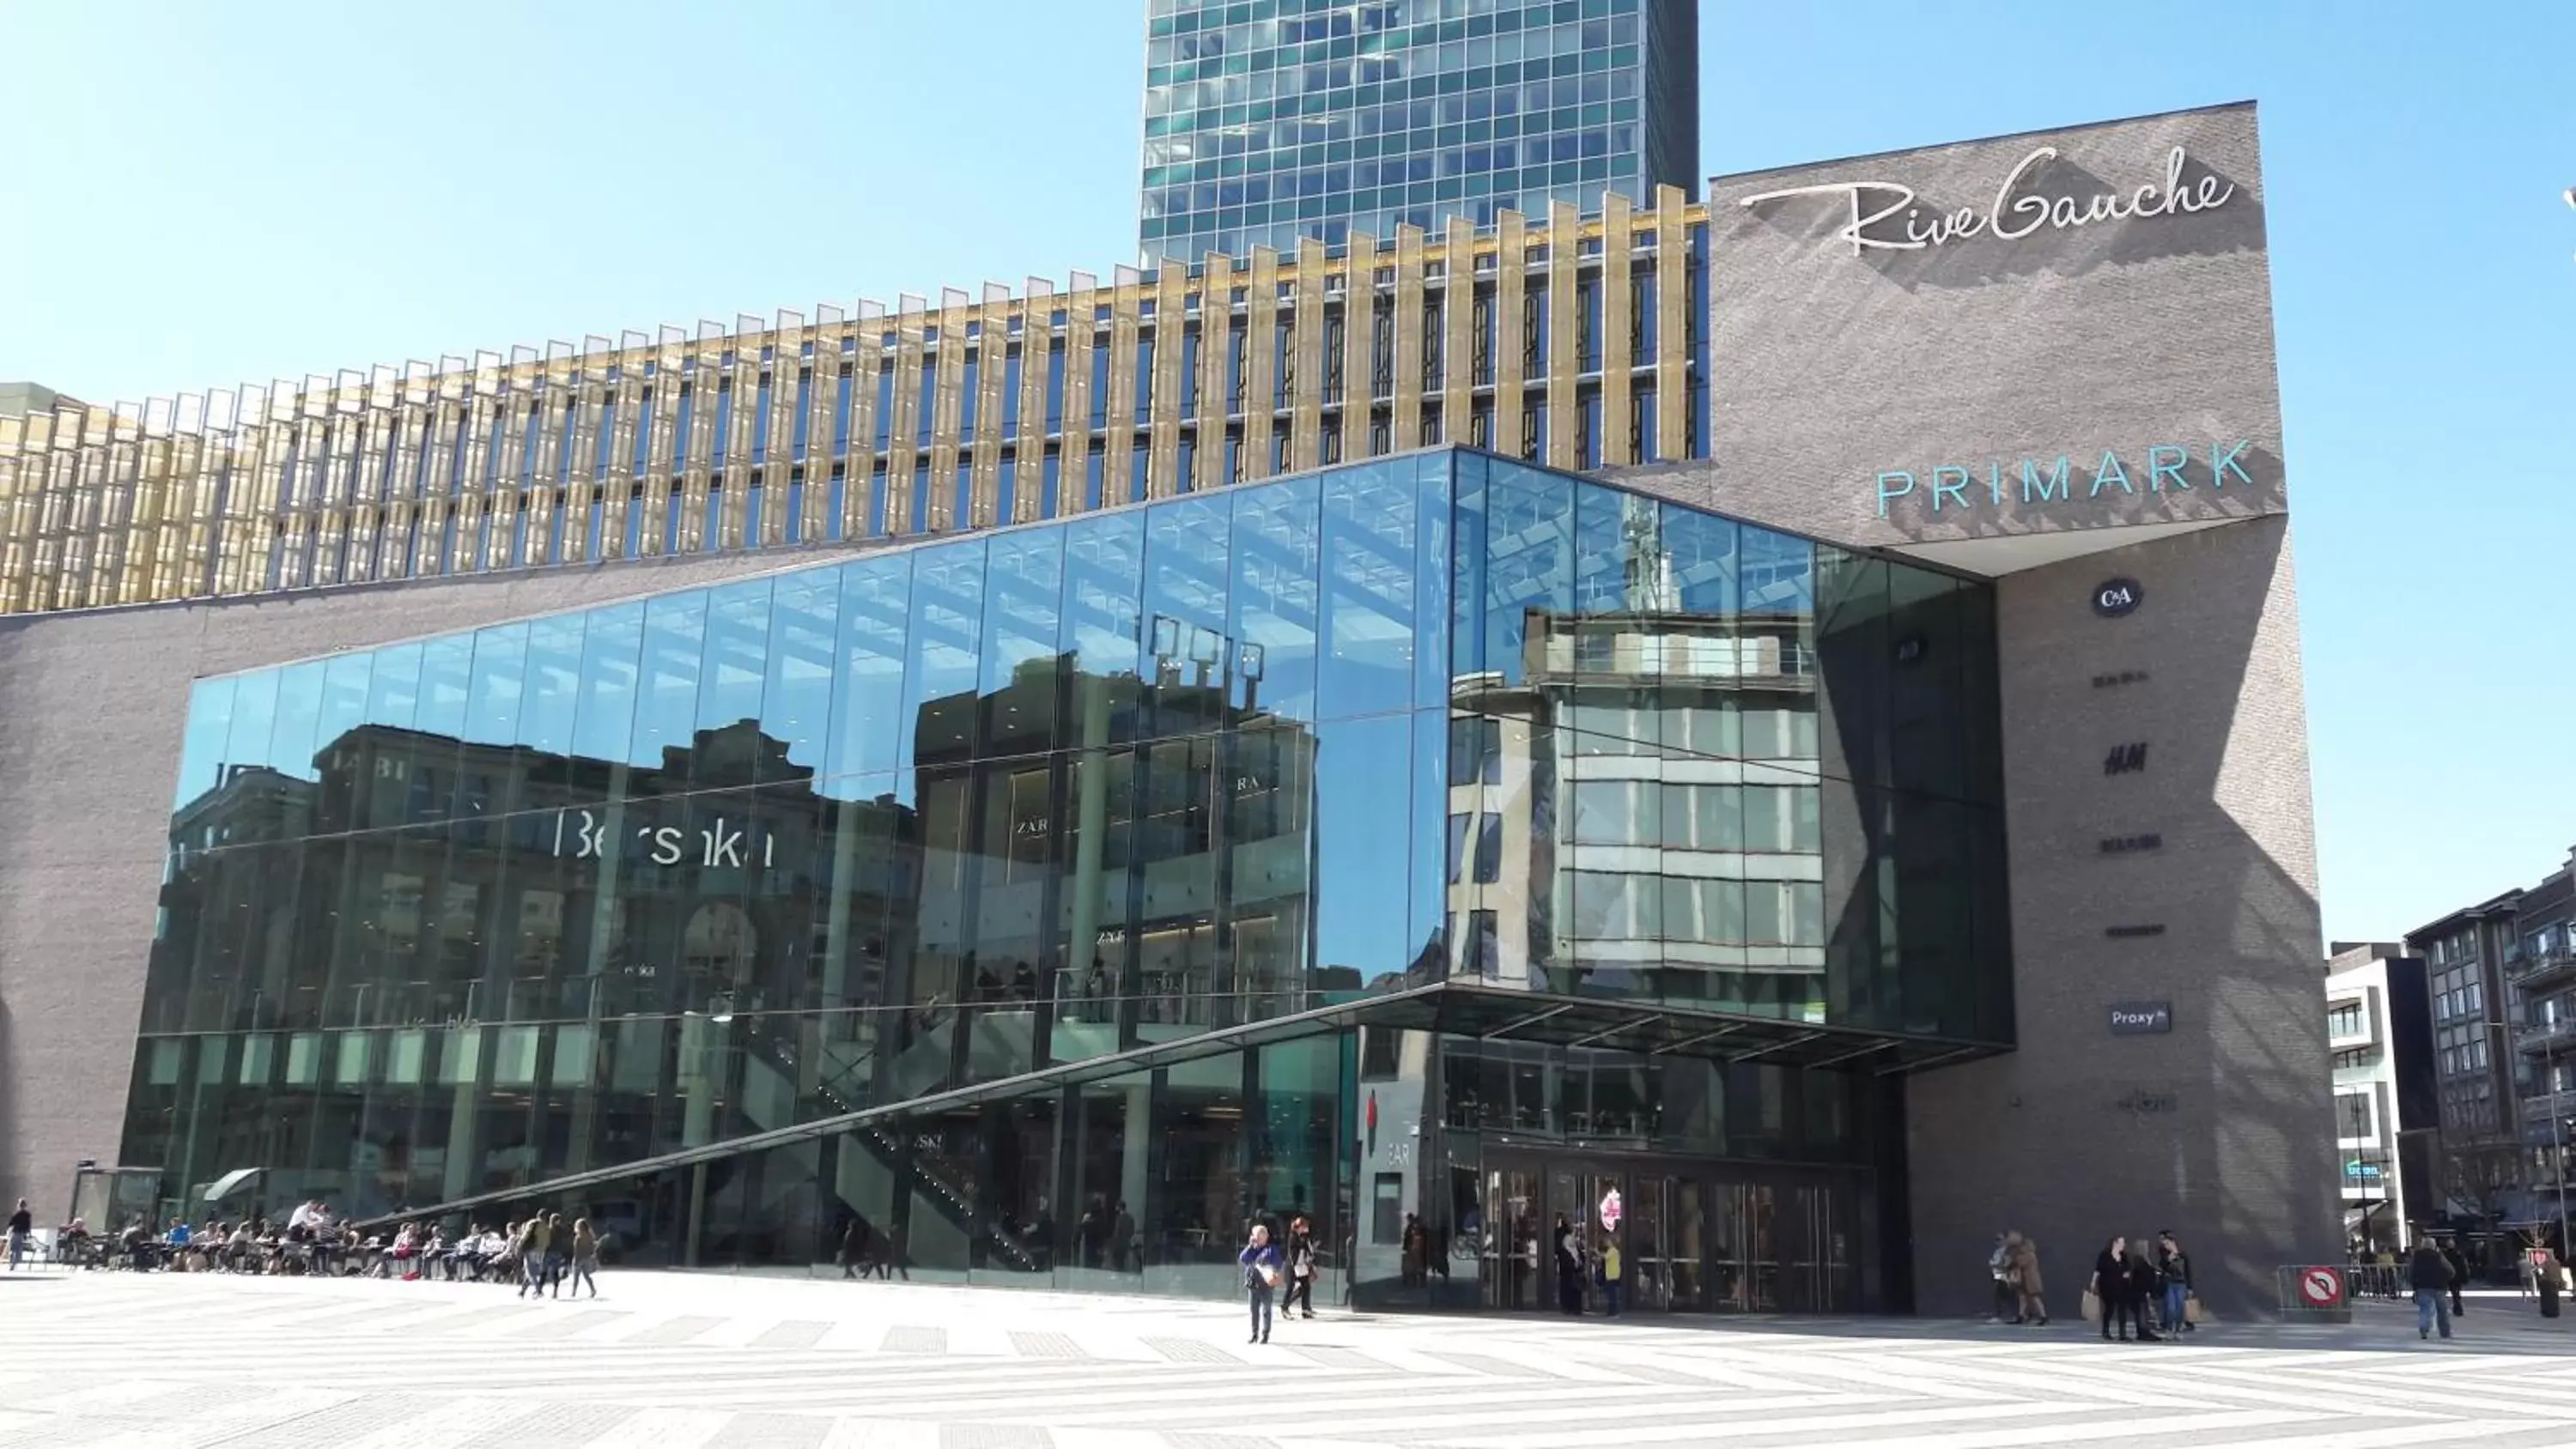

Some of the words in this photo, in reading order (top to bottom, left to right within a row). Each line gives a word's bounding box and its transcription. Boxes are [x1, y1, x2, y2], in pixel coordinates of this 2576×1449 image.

[1741, 180, 1990, 258] Rive
[1990, 144, 2234, 239] Gauche
[1874, 439, 2254, 518] PRIMARK
[2100, 586, 2133, 608] C&A
[2112, 1010, 2155, 1027] Proxy
